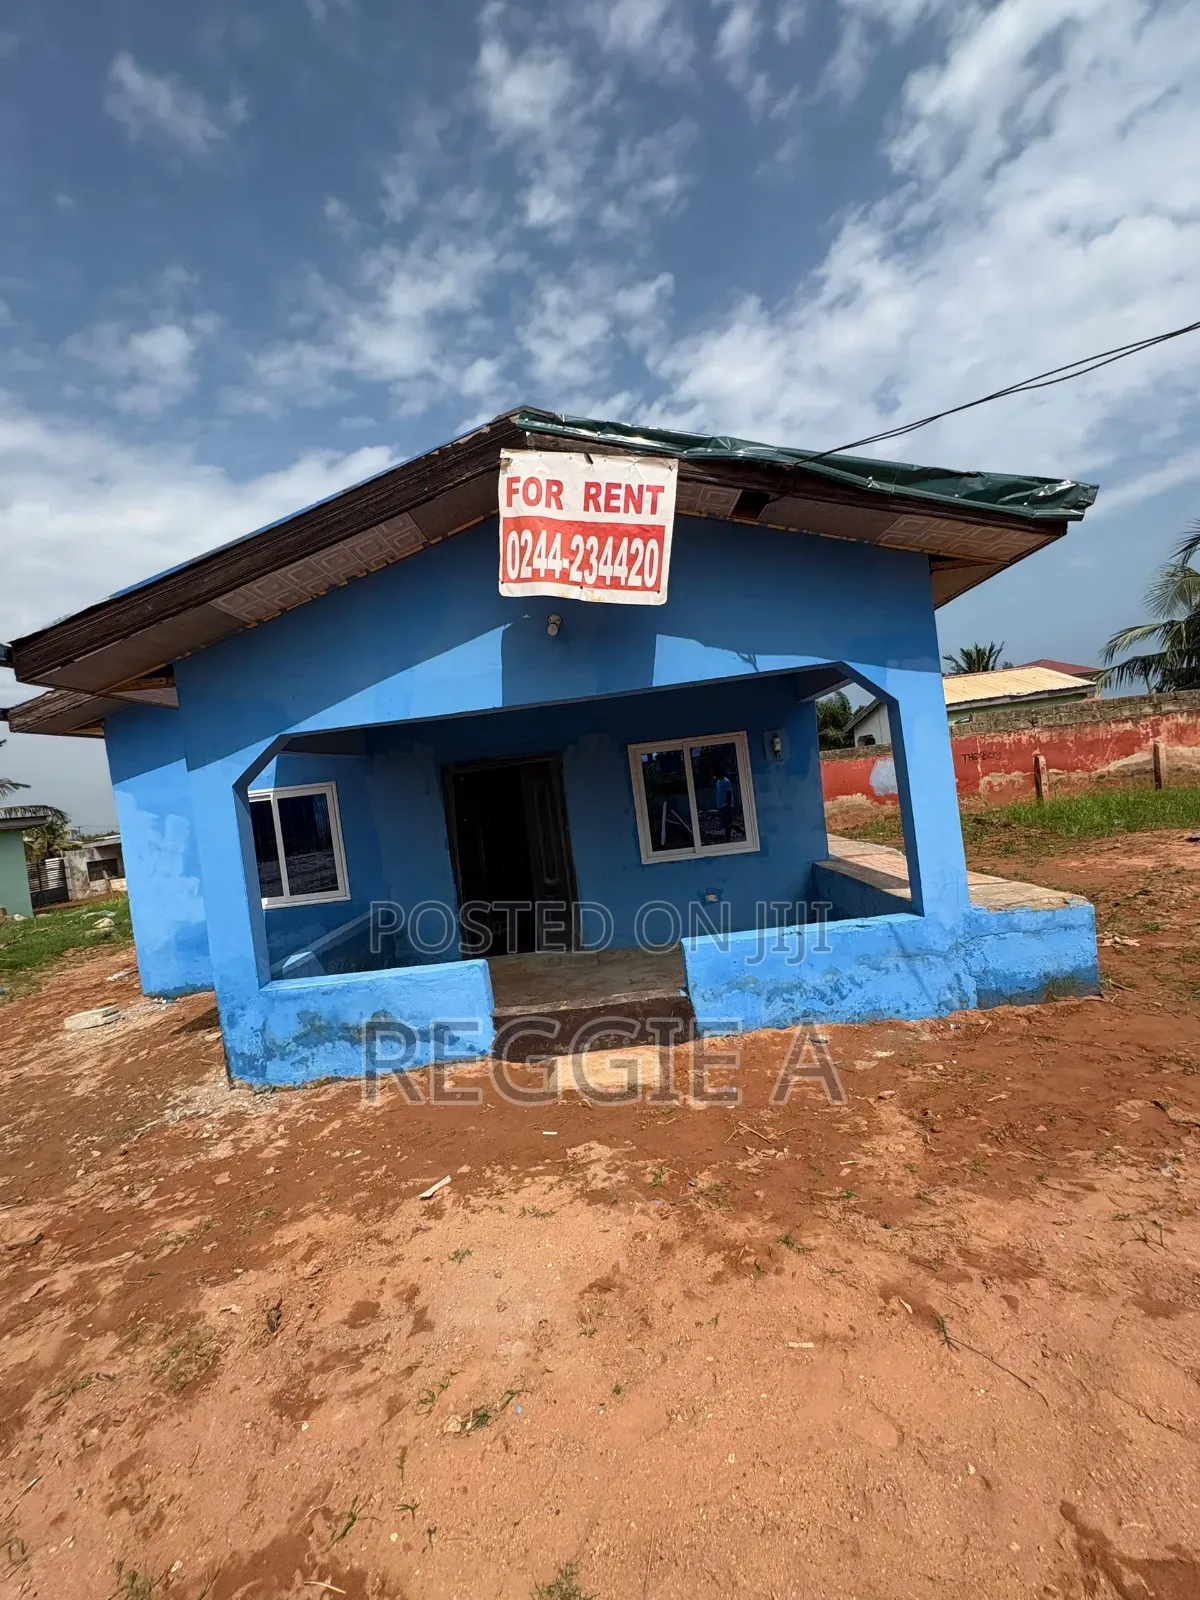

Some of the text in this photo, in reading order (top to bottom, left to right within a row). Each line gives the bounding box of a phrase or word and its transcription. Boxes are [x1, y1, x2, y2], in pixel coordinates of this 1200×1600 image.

[506, 476, 665, 515] FOR RENT
[506, 529, 660, 588] 0244-234420
